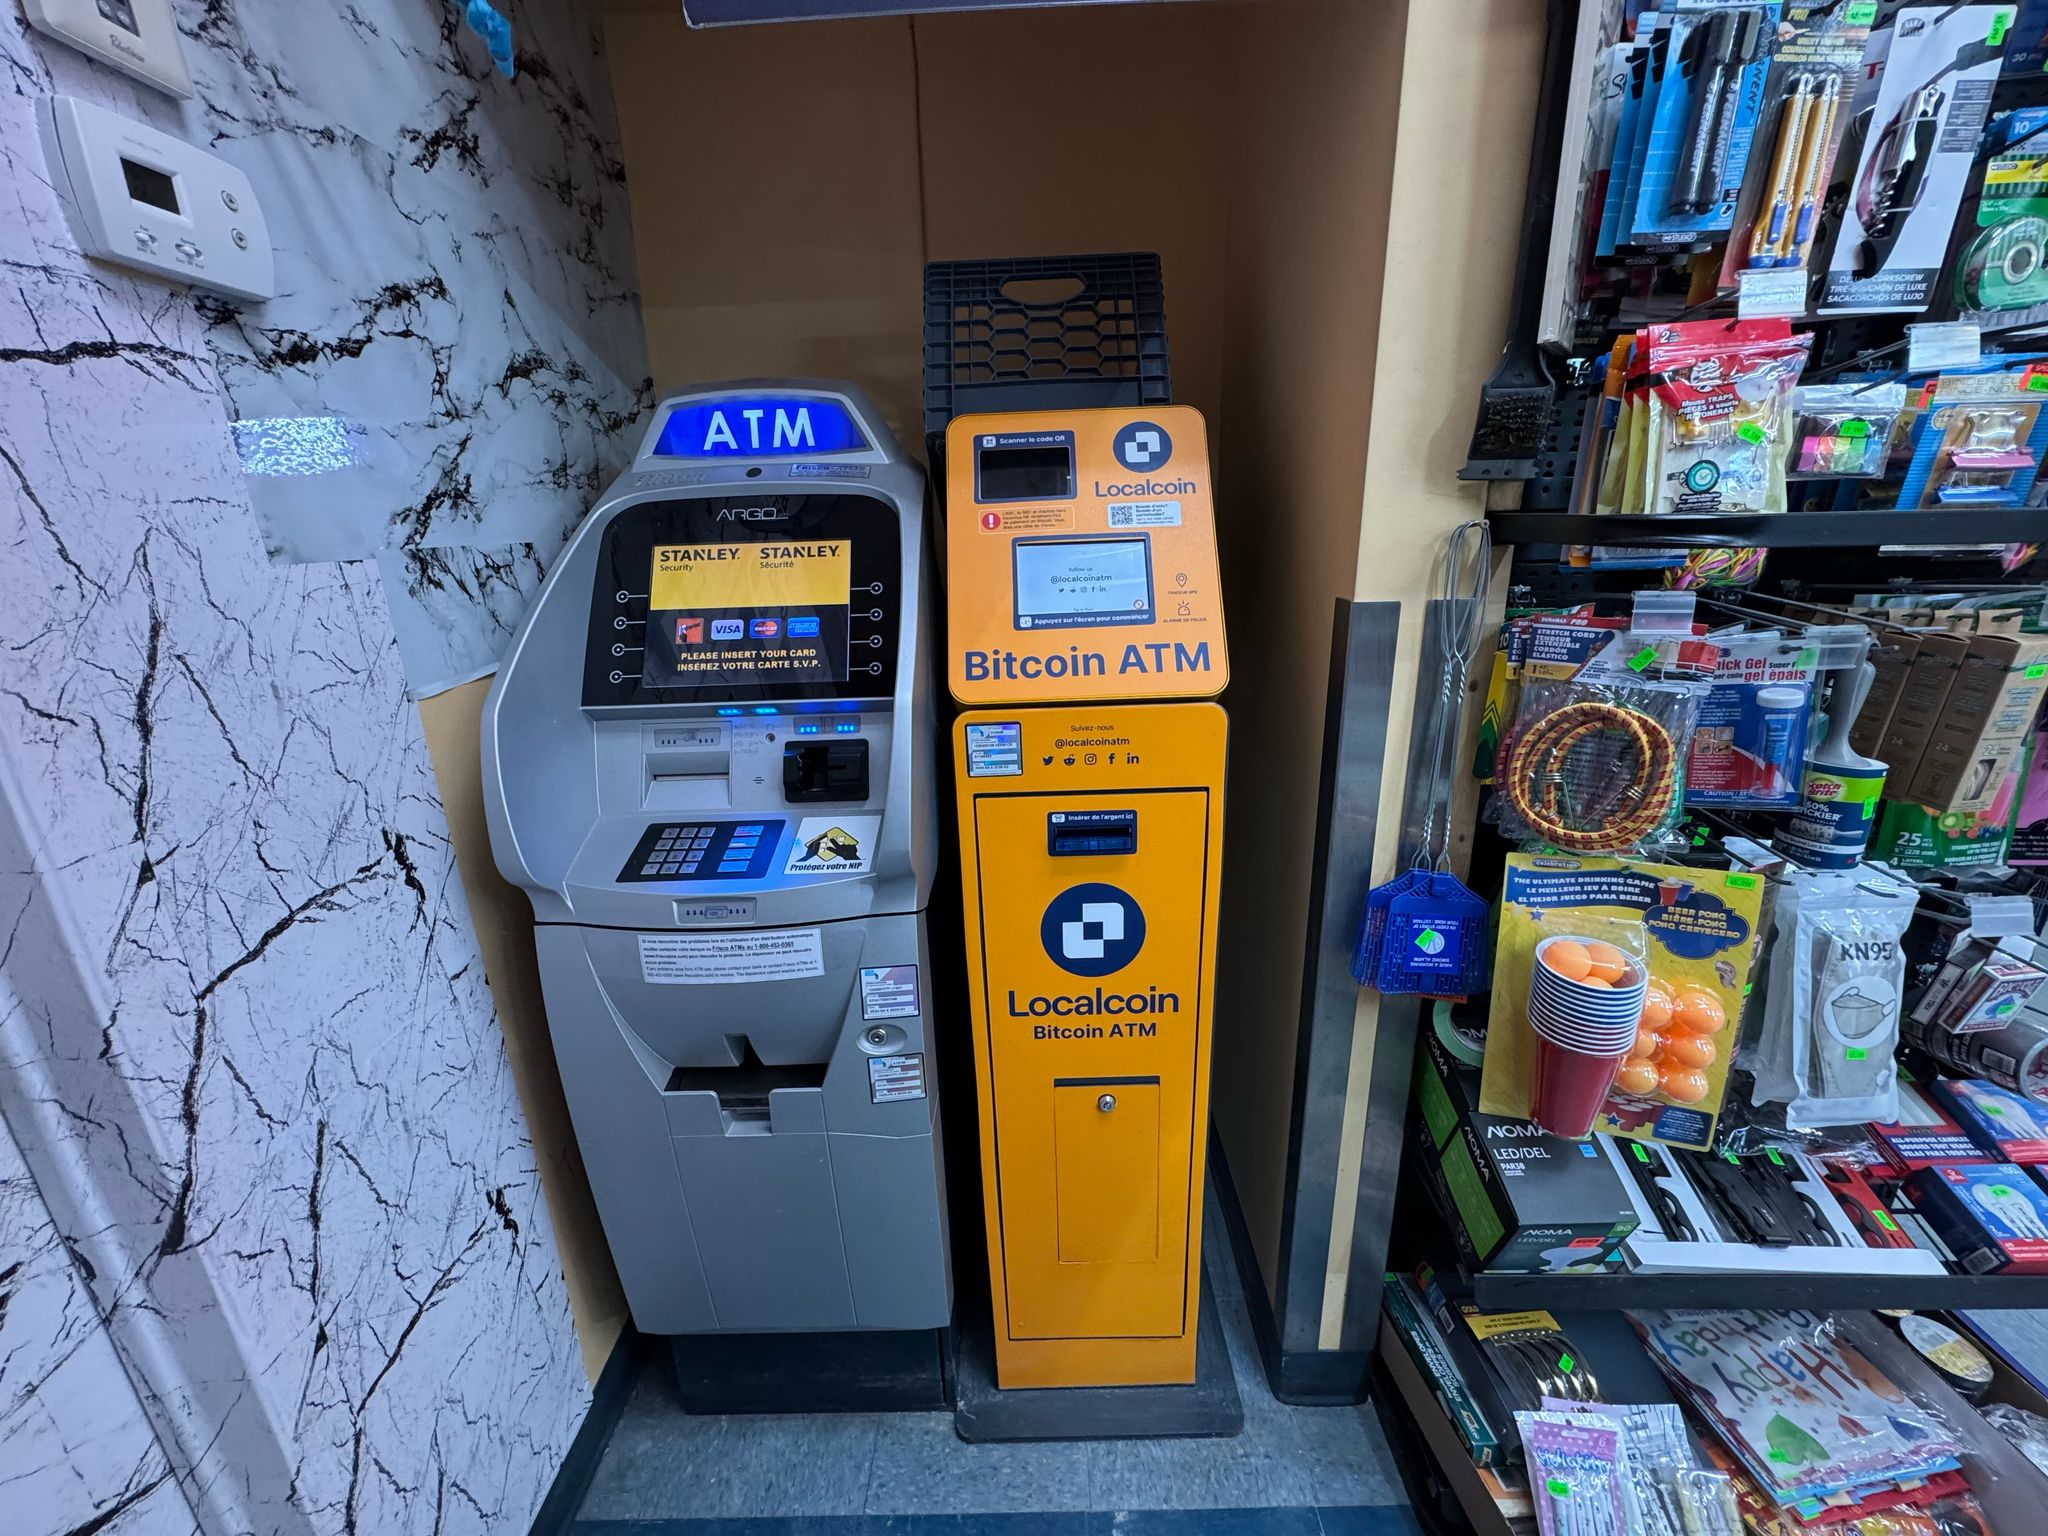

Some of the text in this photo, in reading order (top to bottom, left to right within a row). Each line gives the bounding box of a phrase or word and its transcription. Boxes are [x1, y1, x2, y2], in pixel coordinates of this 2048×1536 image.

[2014, 121, 2029, 133] 10
[1907, 283, 1928, 291] LUXE
[1903, 292, 1924, 300] LUJO
[1660, 331, 1671, 343] 2
[1708, 394, 1735, 403] TRAPS
[703, 407, 816, 450] ATM
[1000, 436, 1028, 445] Scanner
[1036, 435, 1053, 443] code
[1054, 434, 1065, 443] QR
[1094, 478, 1197, 498] Localcoin
[716, 507, 777, 521] ARGO
[660, 545, 840, 562] STANLEY STANLEY
[660, 564, 693, 572] Security
[760, 560, 794, 569] Sécurité
[1050, 575, 1112, 584] @localcoinatm
[1034, 618, 1062, 626] Appuyez
[1074, 615, 1095, 623] l'écran
[1112, 613, 1149, 621] commencer
[714, 625, 741, 634] VISA
[1537, 629, 1596, 639] STRETCH CORD
[1534, 640, 1580, 649] EXTENSIBLE
[1536, 635, 1571, 643] TENDEUR
[681, 649, 817, 661] PLEASE INSERT YOUR CARD
[677, 659, 821, 672] INSÉREZ VOTRE CARTE S.V.P.
[964, 641, 1212, 682] Bitcoin ATM
[1745, 658, 1767, 669] Gel
[1744, 671, 1765, 682] gel
[1768, 669, 1807, 682] épais
[1070, 724, 1114, 732] Suivez-nous
[1055, 737, 1130, 749] @localcoinatm
[1068, 813, 1090, 821] Insérer
[1100, 813, 1125, 822] l'argent
[1896, 832, 1922, 846] 25
[790, 861, 862, 872] Protégez votre NIP
[1889, 857, 1898, 866] 4
[1514, 877, 1531, 885] THE
[1536, 877, 1576, 885] ULTIMATE
[1625, 879, 1655, 889] GAME
[1538, 885, 1582, 894] MEILLEUR
[1611, 885, 1641, 894] BOIRE
[1619, 894, 1652, 903] BEBER
[1667, 906, 1727, 920] BEER PONG
[1648, 920, 1741, 938] PONG CERVECERO
[1839, 942, 1893, 961] KN95
[1008, 986, 1179, 1017] Localcoin
[1033, 1023, 1156, 1039] Bitcoin ATM
[1426, 1032, 1448, 1077] NOMA
[1464, 1126, 1490, 1182] NOMA
[1493, 1147, 1551, 1159] LED/DEL
[1712, 1342, 1860, 1406] Happy
